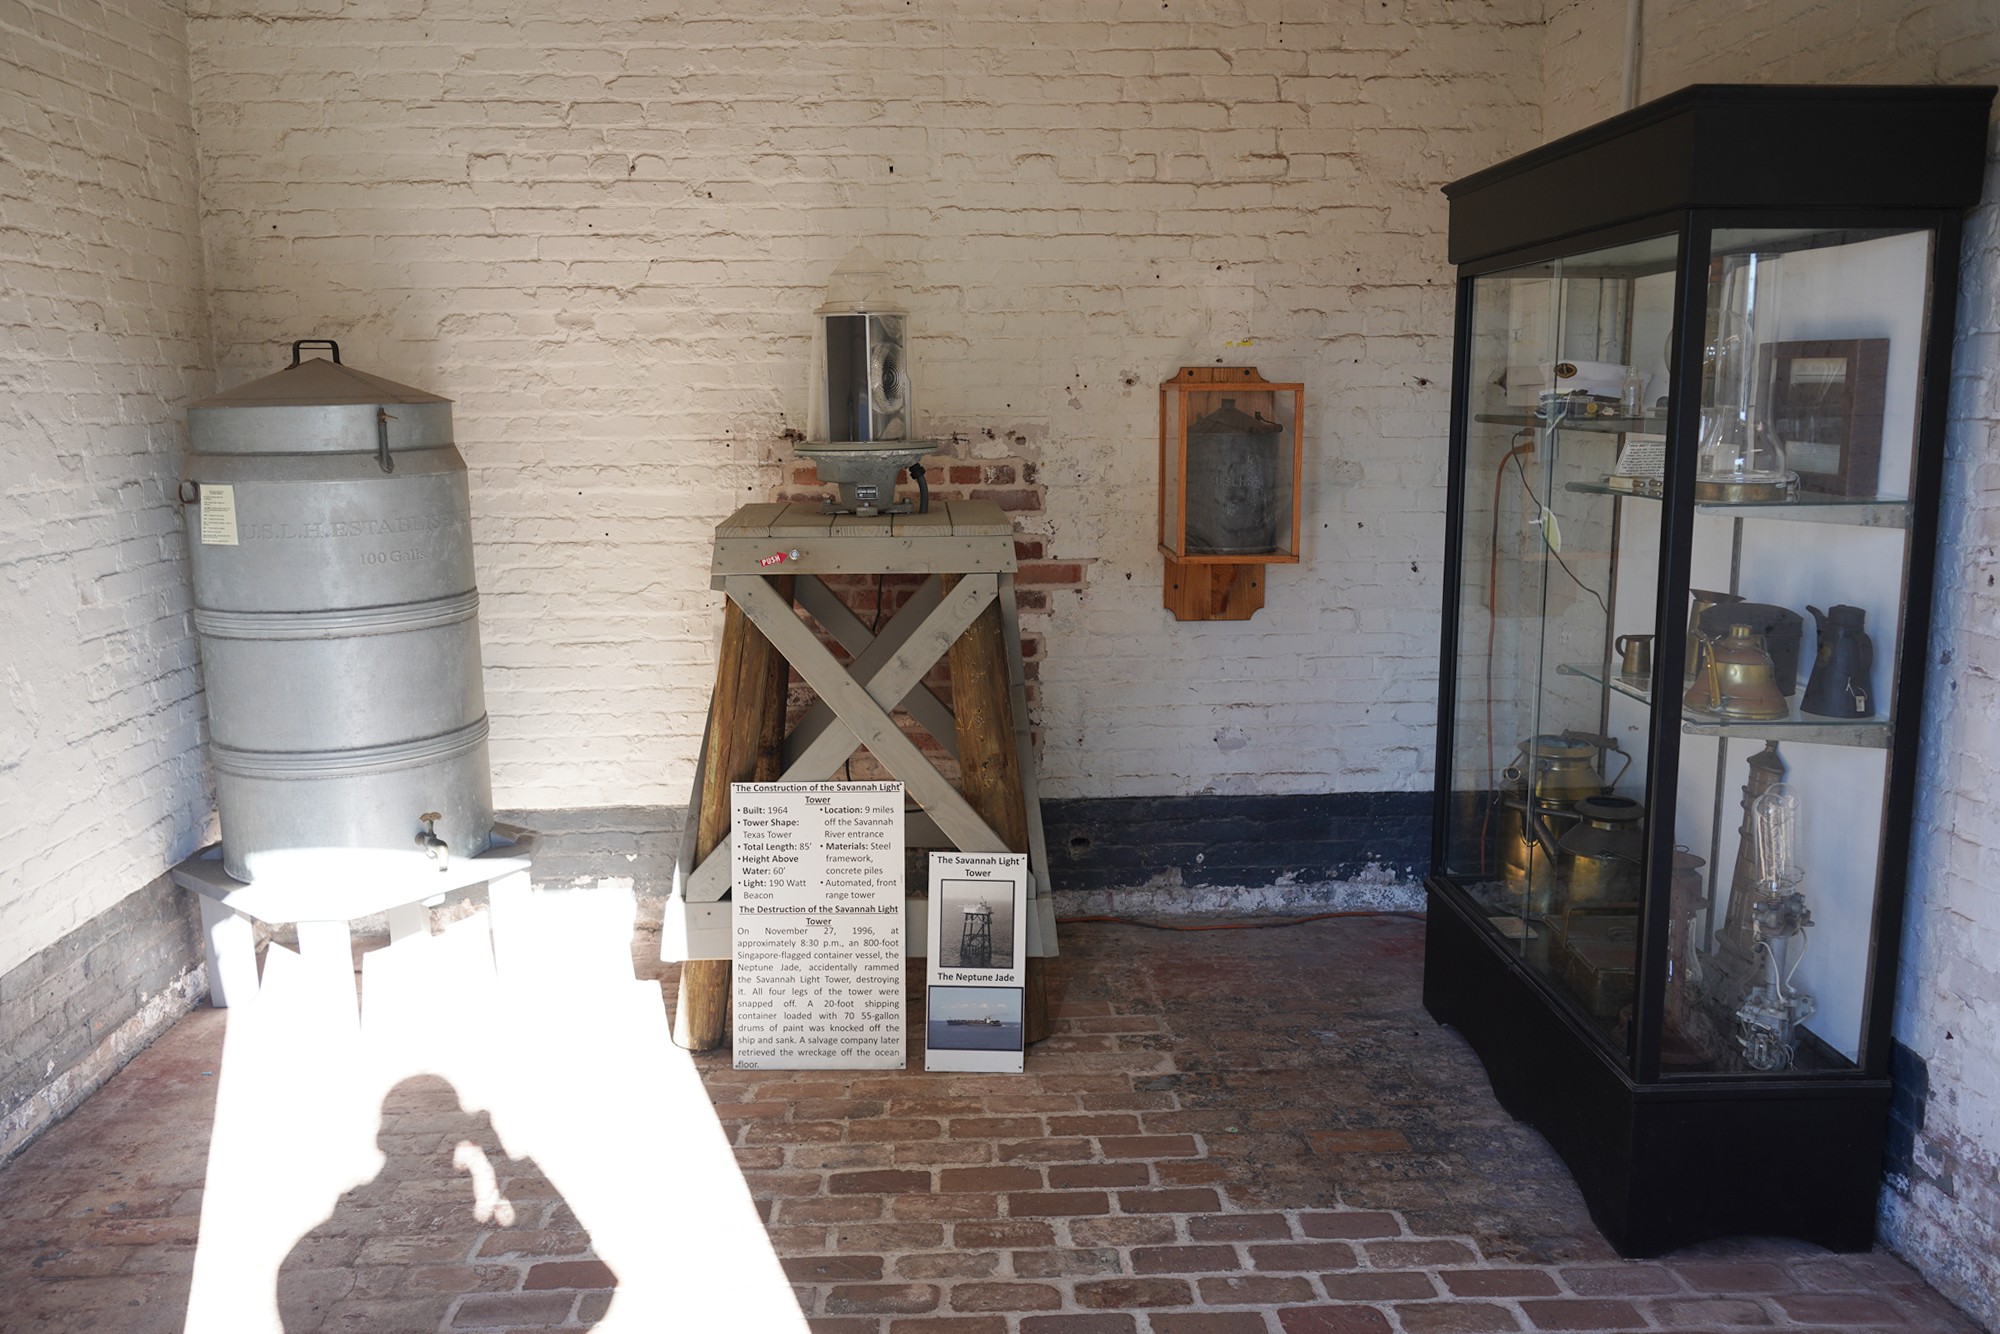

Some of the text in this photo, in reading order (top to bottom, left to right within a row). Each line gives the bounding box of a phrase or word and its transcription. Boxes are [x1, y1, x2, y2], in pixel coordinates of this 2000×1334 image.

[360, 553, 386, 565] 100
[761, 555, 781, 566] PUSH
[766, 843, 797, 852] Length:
[743, 855, 770, 863] Height
[826, 855, 873, 863] framework,
[955, 856, 996, 865] Savannah
[999, 857, 1019, 866] Light
[864, 867, 883, 876] piles
[878, 906, 898, 914] Light
[738, 940, 796, 948] approximately
[738, 952, 811, 961] Singapore-flagged
[855, 952, 882, 960] vessel,
[738, 964, 773, 972] Neptune
[809, 964, 857, 972] accidentally
[800, 976, 820, 984] Light
[856, 976, 899, 985] destroying
[956, 973, 992, 983] Neptune
[995, 974, 1014, 982] Jade
[792, 988, 808, 997] legs
[738, 1000, 773, 1009] snapped
[865, 1000, 899, 1009] shipping
[861, 1012, 899, 1021] 55-gallon
[783, 1025, 804, 1033] paint
[738, 1037, 755, 1045] ship
[808, 1037, 838, 1045] salvage
[798, 1049, 837, 1058] wreckage
